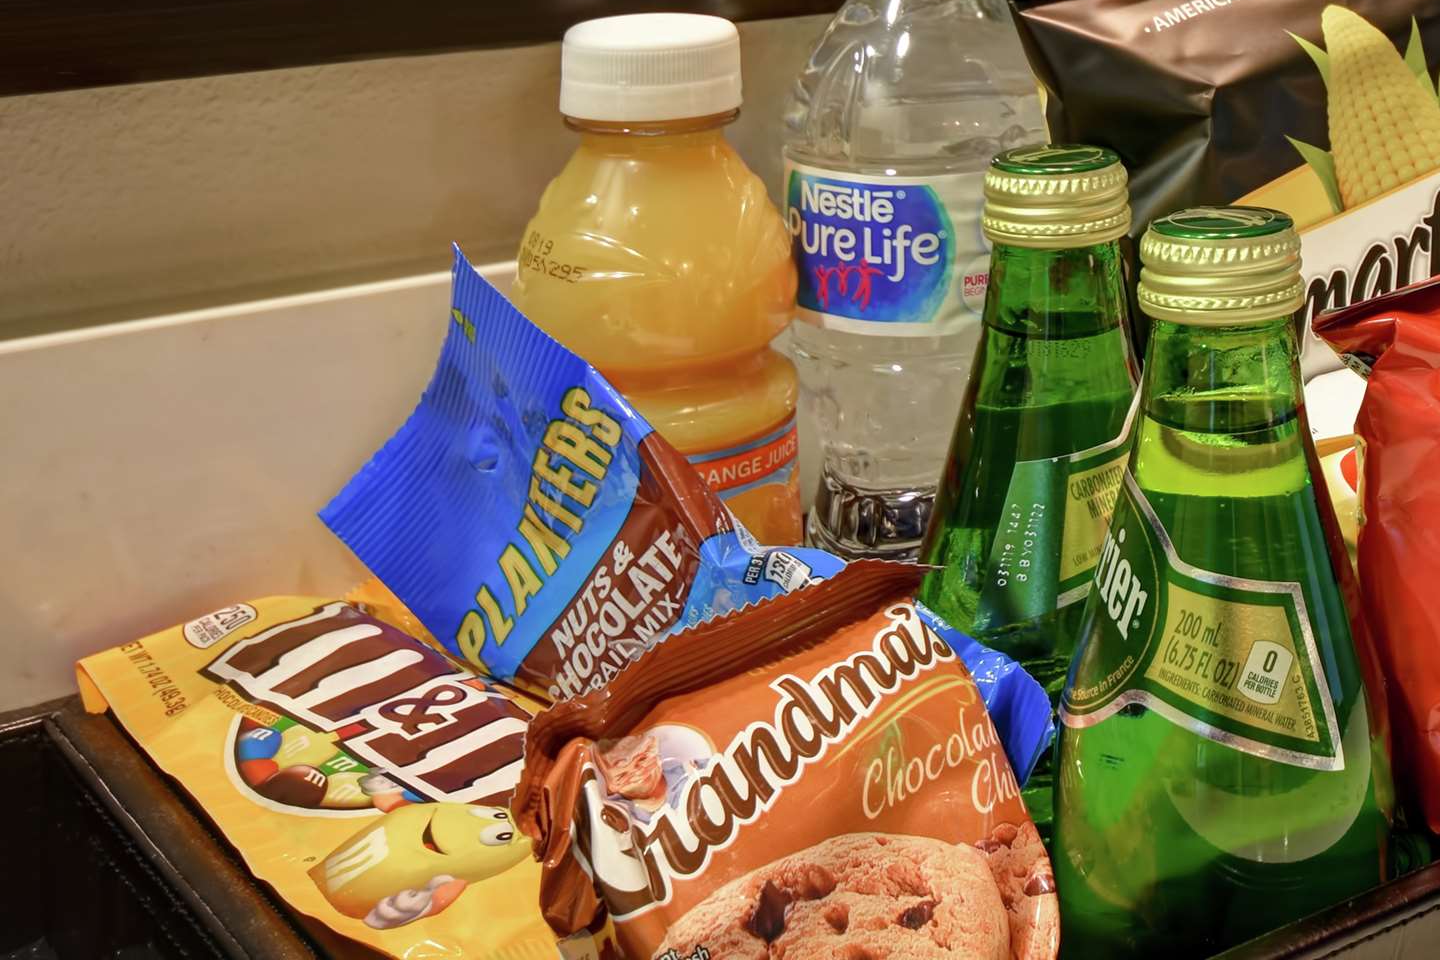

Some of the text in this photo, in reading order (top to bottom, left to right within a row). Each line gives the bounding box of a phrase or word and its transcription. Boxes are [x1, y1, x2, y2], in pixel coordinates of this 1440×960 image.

[863, 224, 940, 282] Life
[698, 435, 797, 485] ANGE JUICE
[456, 386, 623, 677] PLANTERS
[551, 540, 635, 660] NUTS &
[1095, 527, 1148, 641] rier
[213, 605, 252, 631] 250
[548, 529, 683, 703] CHOCOLATE
[632, 592, 681, 644] MIX
[1174, 609, 1222, 648] 200 mL
[120, 641, 143, 652] ET
[1163, 635, 1241, 691] (6.75 FL OZ)
[1263, 650, 1278, 674] 0
[1201, 685, 1246, 713] CARBONATED
[1243, 680, 1277, 699] PER BOTTLE
[1247, 671, 1280, 690] CALORIES
